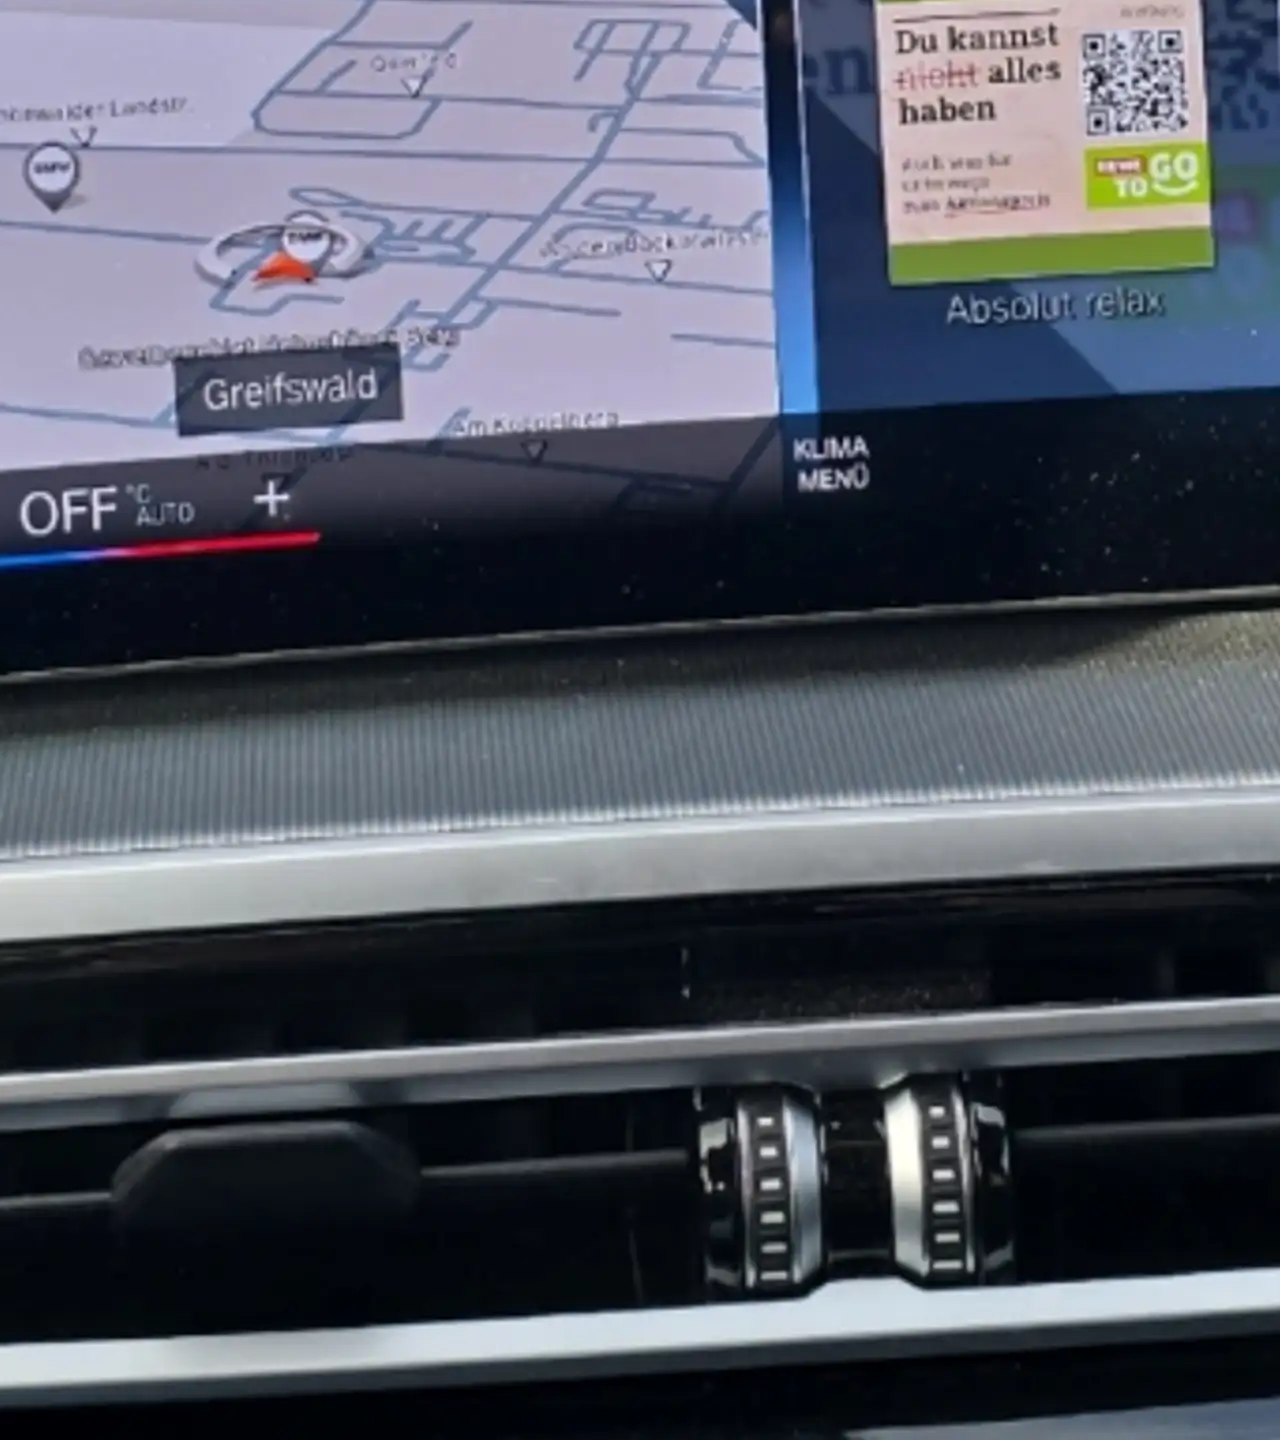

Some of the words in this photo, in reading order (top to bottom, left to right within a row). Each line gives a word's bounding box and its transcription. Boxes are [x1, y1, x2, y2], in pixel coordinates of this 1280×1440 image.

[895, 27, 938, 55] Du
[947, 22, 1060, 53] kannst
[987, 56, 1062, 85] alles
[898, 97, 997, 125] haben
[1149, 151, 1198, 182] GO
[946, 292, 1074, 326] Absolut
[1085, 287, 1164, 318] relax
[203, 367, 378, 410] Greifswald
[793, 435, 870, 461] KLIMA
[798, 462, 870, 492] MENÜ
[19, 485, 118, 537] OFF
[135, 501, 196, 527] AUTO
